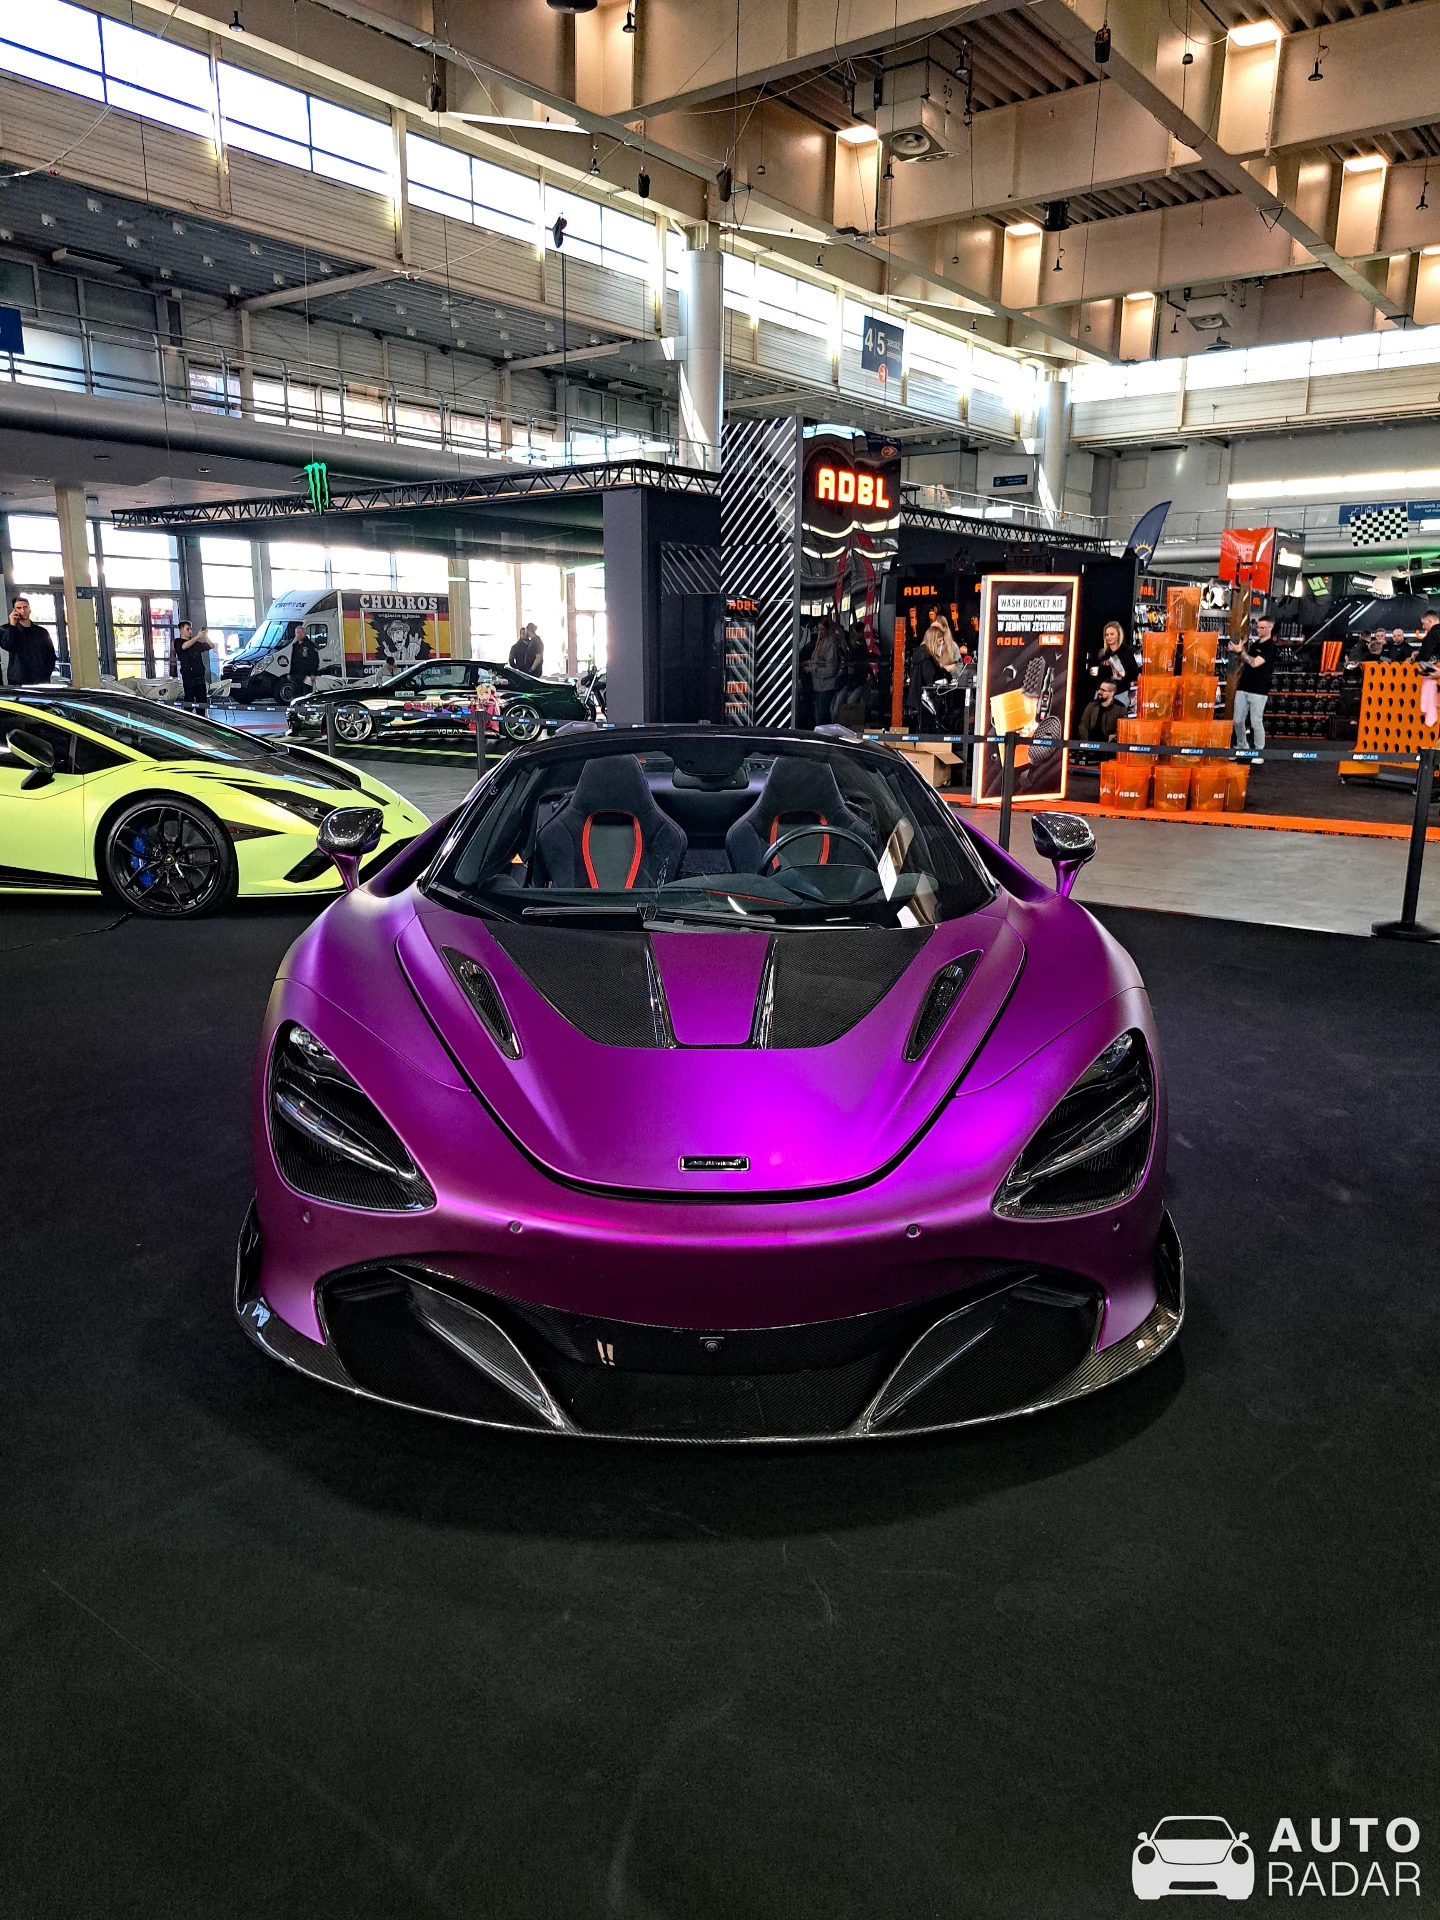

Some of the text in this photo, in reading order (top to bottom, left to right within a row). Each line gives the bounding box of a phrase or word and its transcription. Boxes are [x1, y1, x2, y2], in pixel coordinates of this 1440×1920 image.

[818, 467, 890, 509] ADBL
[904, 586, 938, 596] ADBL
[360, 594, 438, 609] CHURROS
[728, 600, 758, 611] ADBL
[1000, 598, 1064, 608] WASH BUCKET KIT
[1005, 621, 1031, 632] JEDNYM
[996, 637, 1025, 646] ADBL
